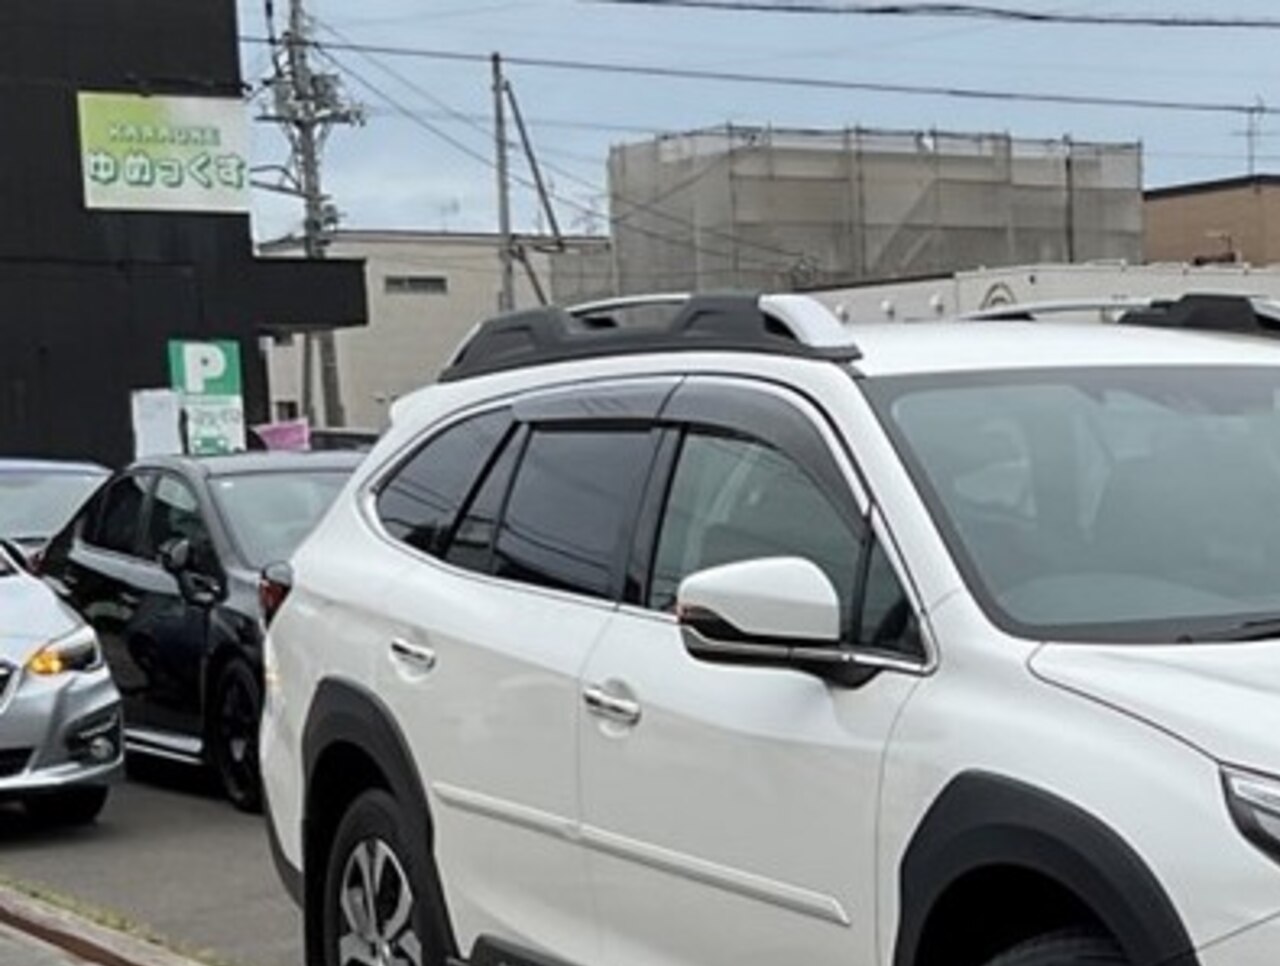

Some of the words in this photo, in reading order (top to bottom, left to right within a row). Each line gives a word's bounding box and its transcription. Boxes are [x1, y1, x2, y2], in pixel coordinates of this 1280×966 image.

[88, 151, 246, 189] ゆめっくす
[183, 342, 226, 393] P
